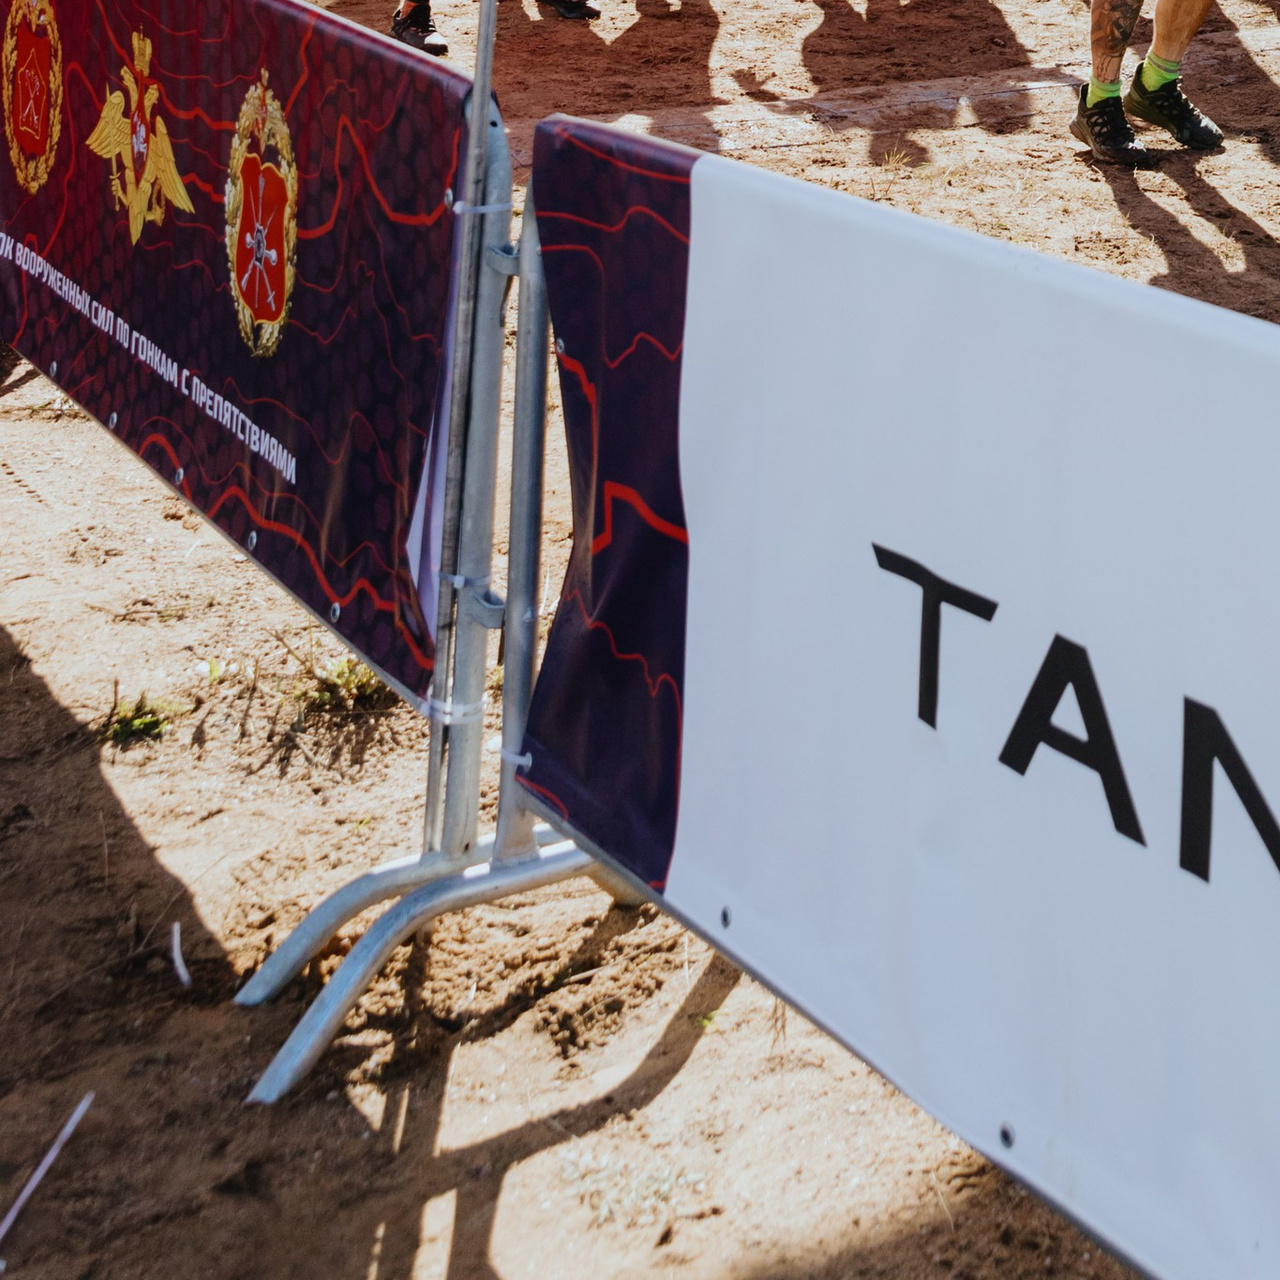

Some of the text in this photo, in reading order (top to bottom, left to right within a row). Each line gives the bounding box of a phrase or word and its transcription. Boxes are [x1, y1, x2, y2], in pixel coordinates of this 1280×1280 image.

[15, 242, 90, 318] ВООРУЖЕННЫХ
[91, 300, 114, 336] СИЛ
[117, 317, 130, 349] ПО
[131, 330, 178, 388] ГОНКАМ
[181, 368, 190, 396] С
[192, 375, 297, 485] ПРЕПЯТСТВИЯМИ
